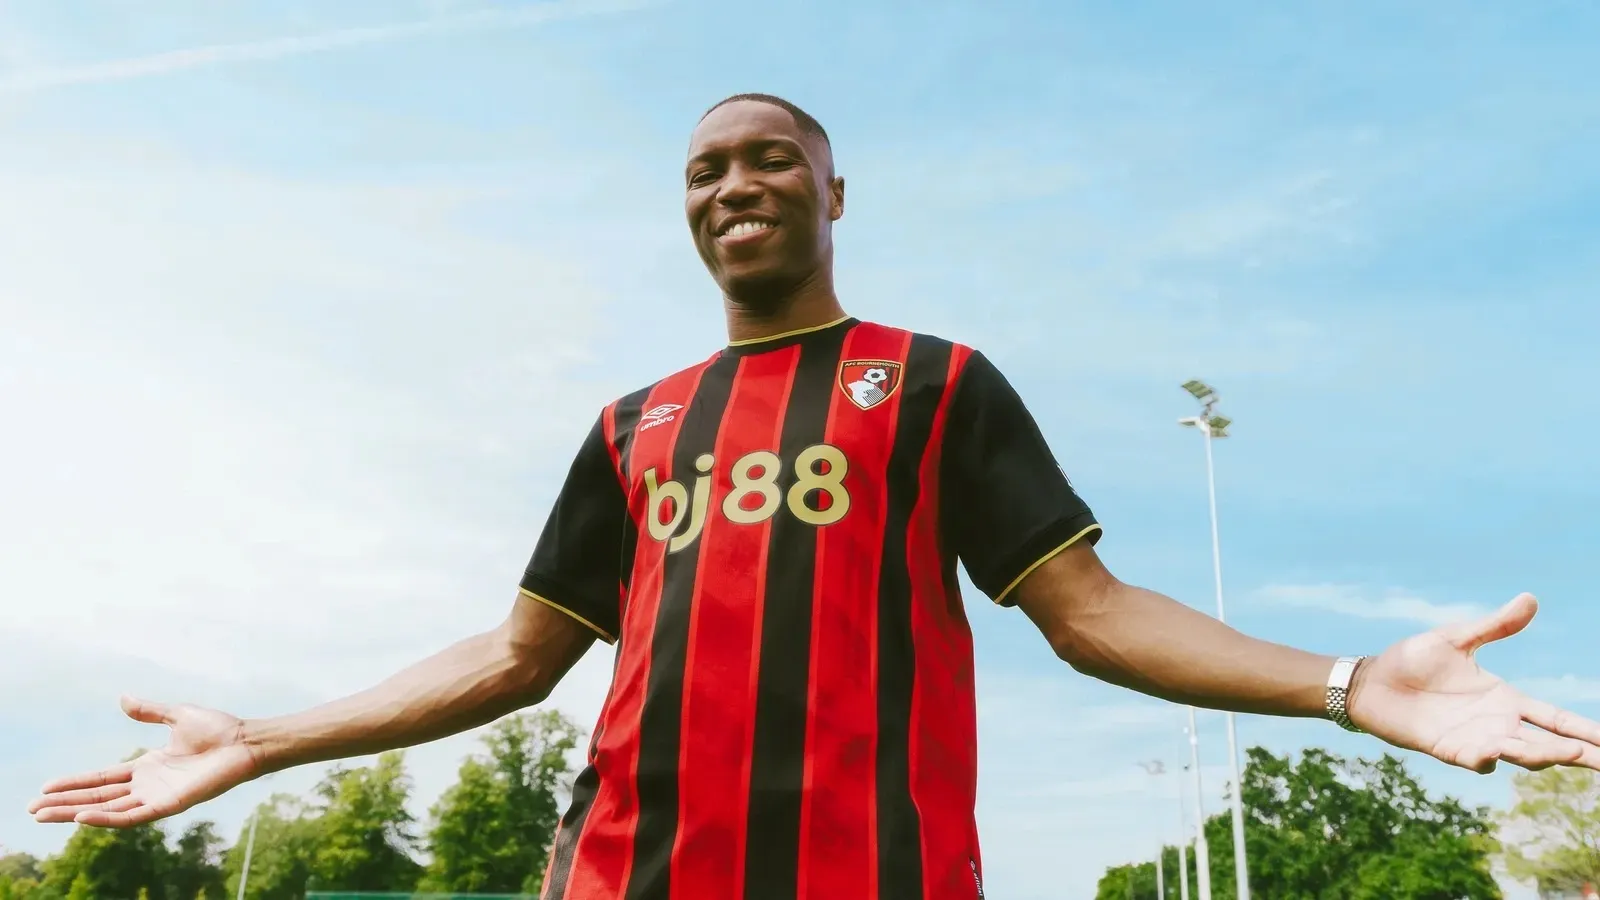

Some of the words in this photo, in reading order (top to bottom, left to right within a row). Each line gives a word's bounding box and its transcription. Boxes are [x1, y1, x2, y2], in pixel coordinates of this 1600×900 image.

[856, 361, 900, 369] BOURNEMOUTH
[640, 415, 675, 432] umbro
[644, 444, 850, 553] bj88
